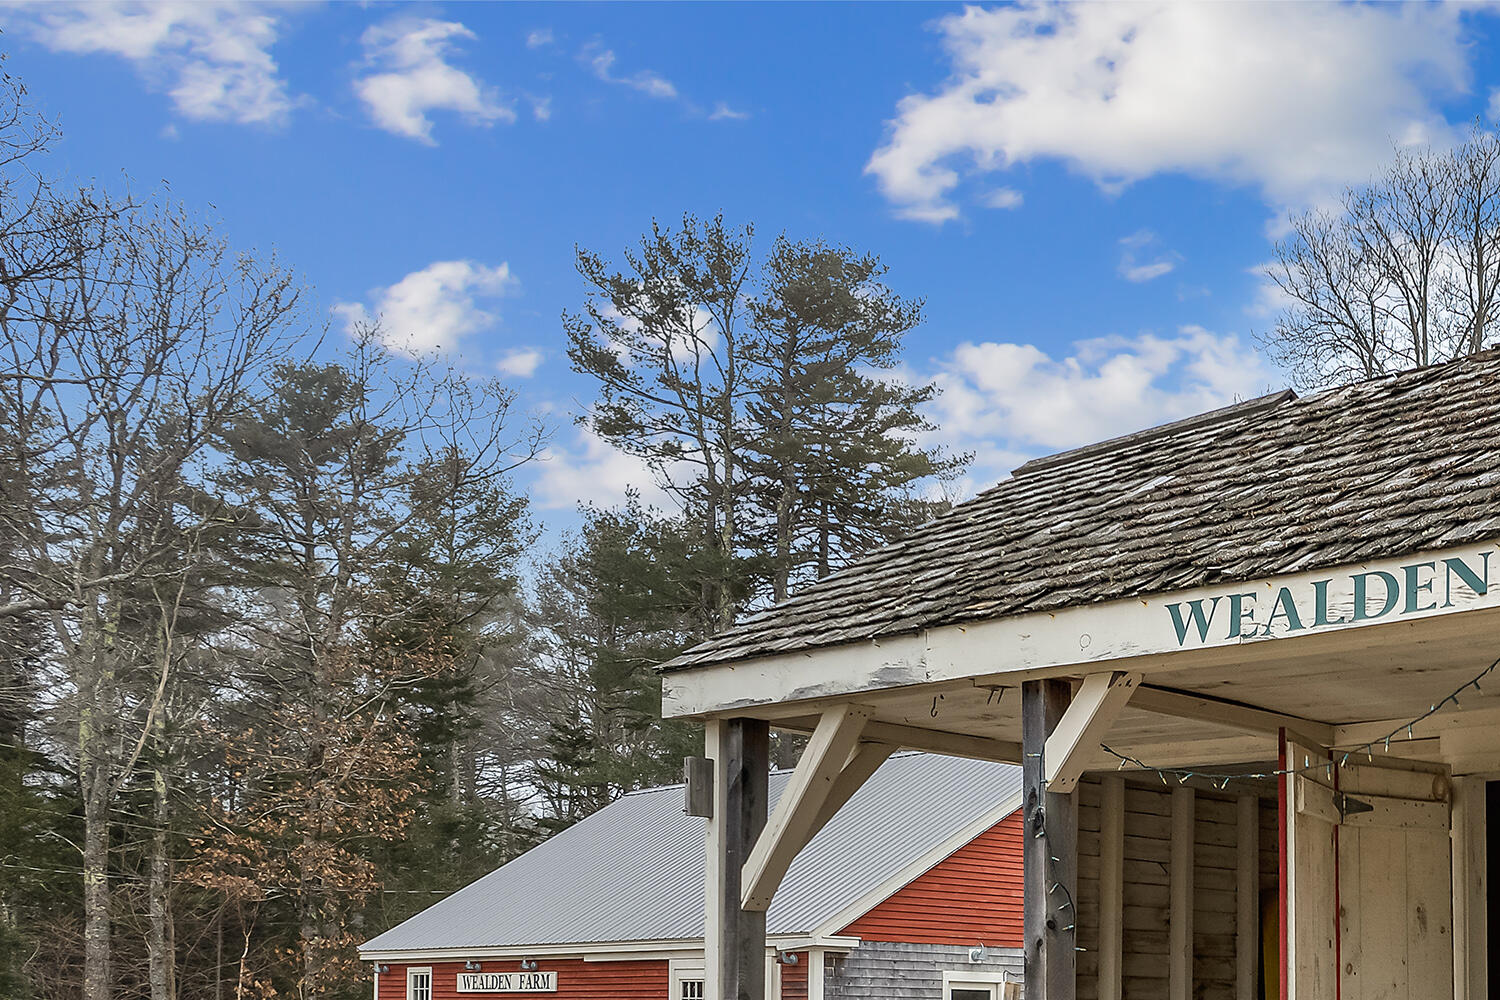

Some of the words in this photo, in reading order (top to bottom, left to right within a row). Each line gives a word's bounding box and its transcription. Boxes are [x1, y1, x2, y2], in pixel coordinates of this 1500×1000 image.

[1165, 551, 1494, 647] WEALDEN
[462, 974, 512, 989] WEALDEN
[519, 974, 551, 989] FARM
